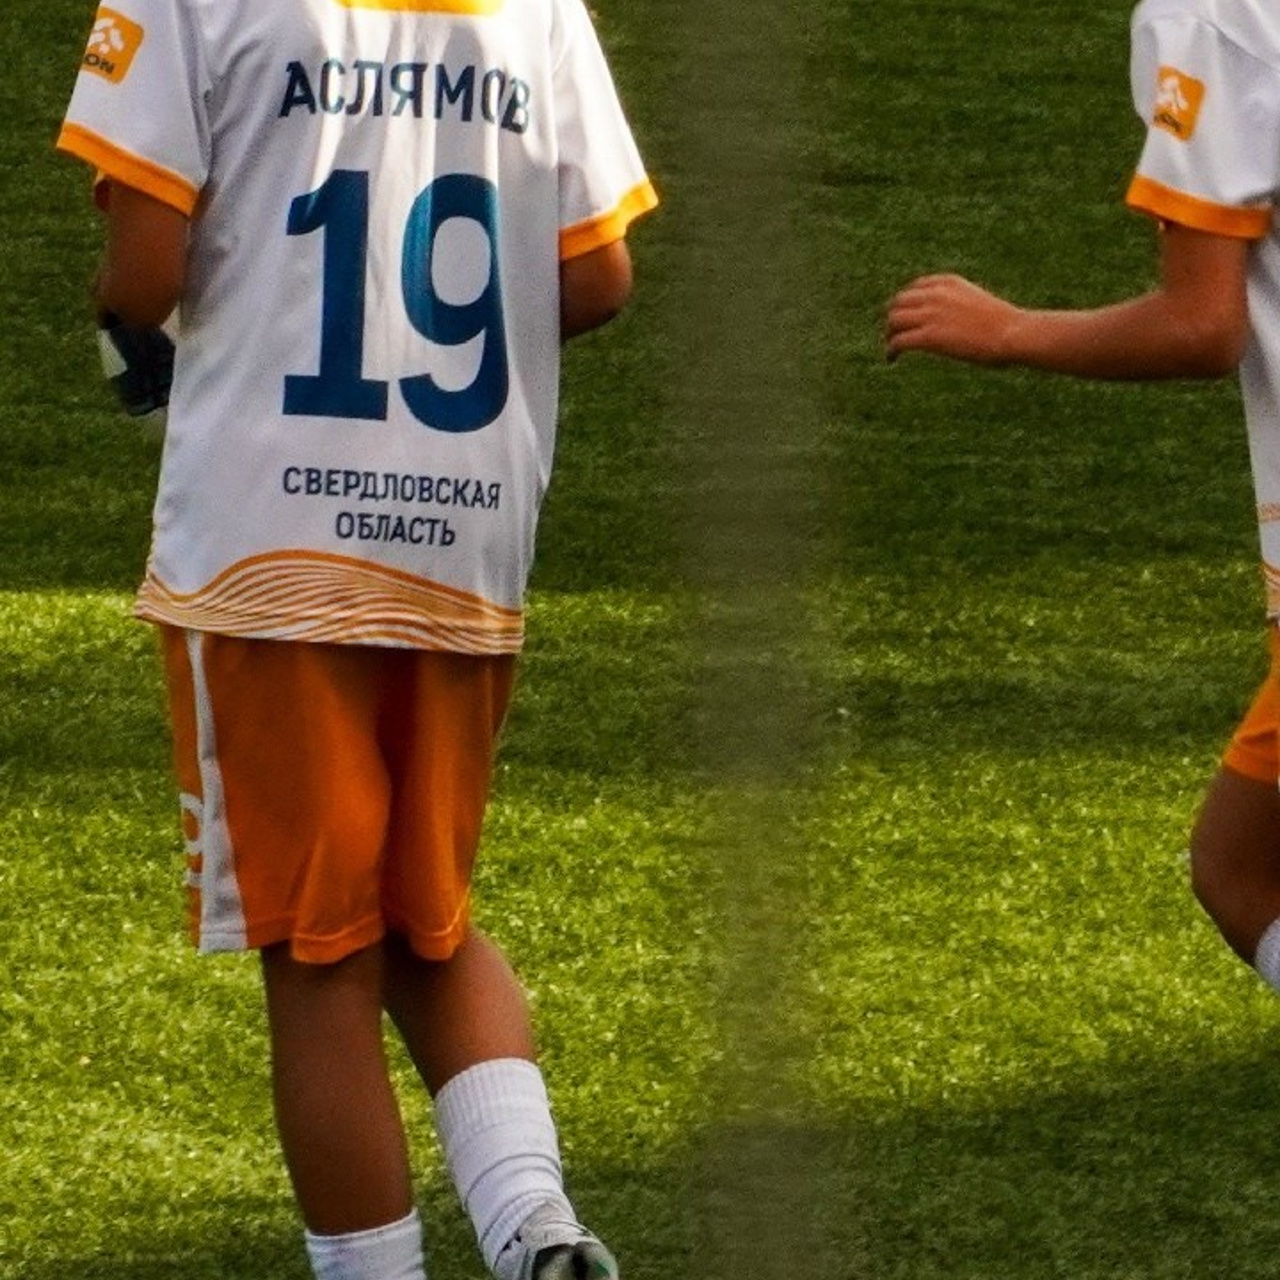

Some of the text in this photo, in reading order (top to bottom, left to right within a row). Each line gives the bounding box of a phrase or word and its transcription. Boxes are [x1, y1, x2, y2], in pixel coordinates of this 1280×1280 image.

[278, 57, 531, 135] АСЛЯМОВ
[282, 169, 510, 433] 19
[282, 467, 502, 510] СВЕРДЛОВСКАЯ
[335, 511, 456, 547] ОБЛАСТЬ
